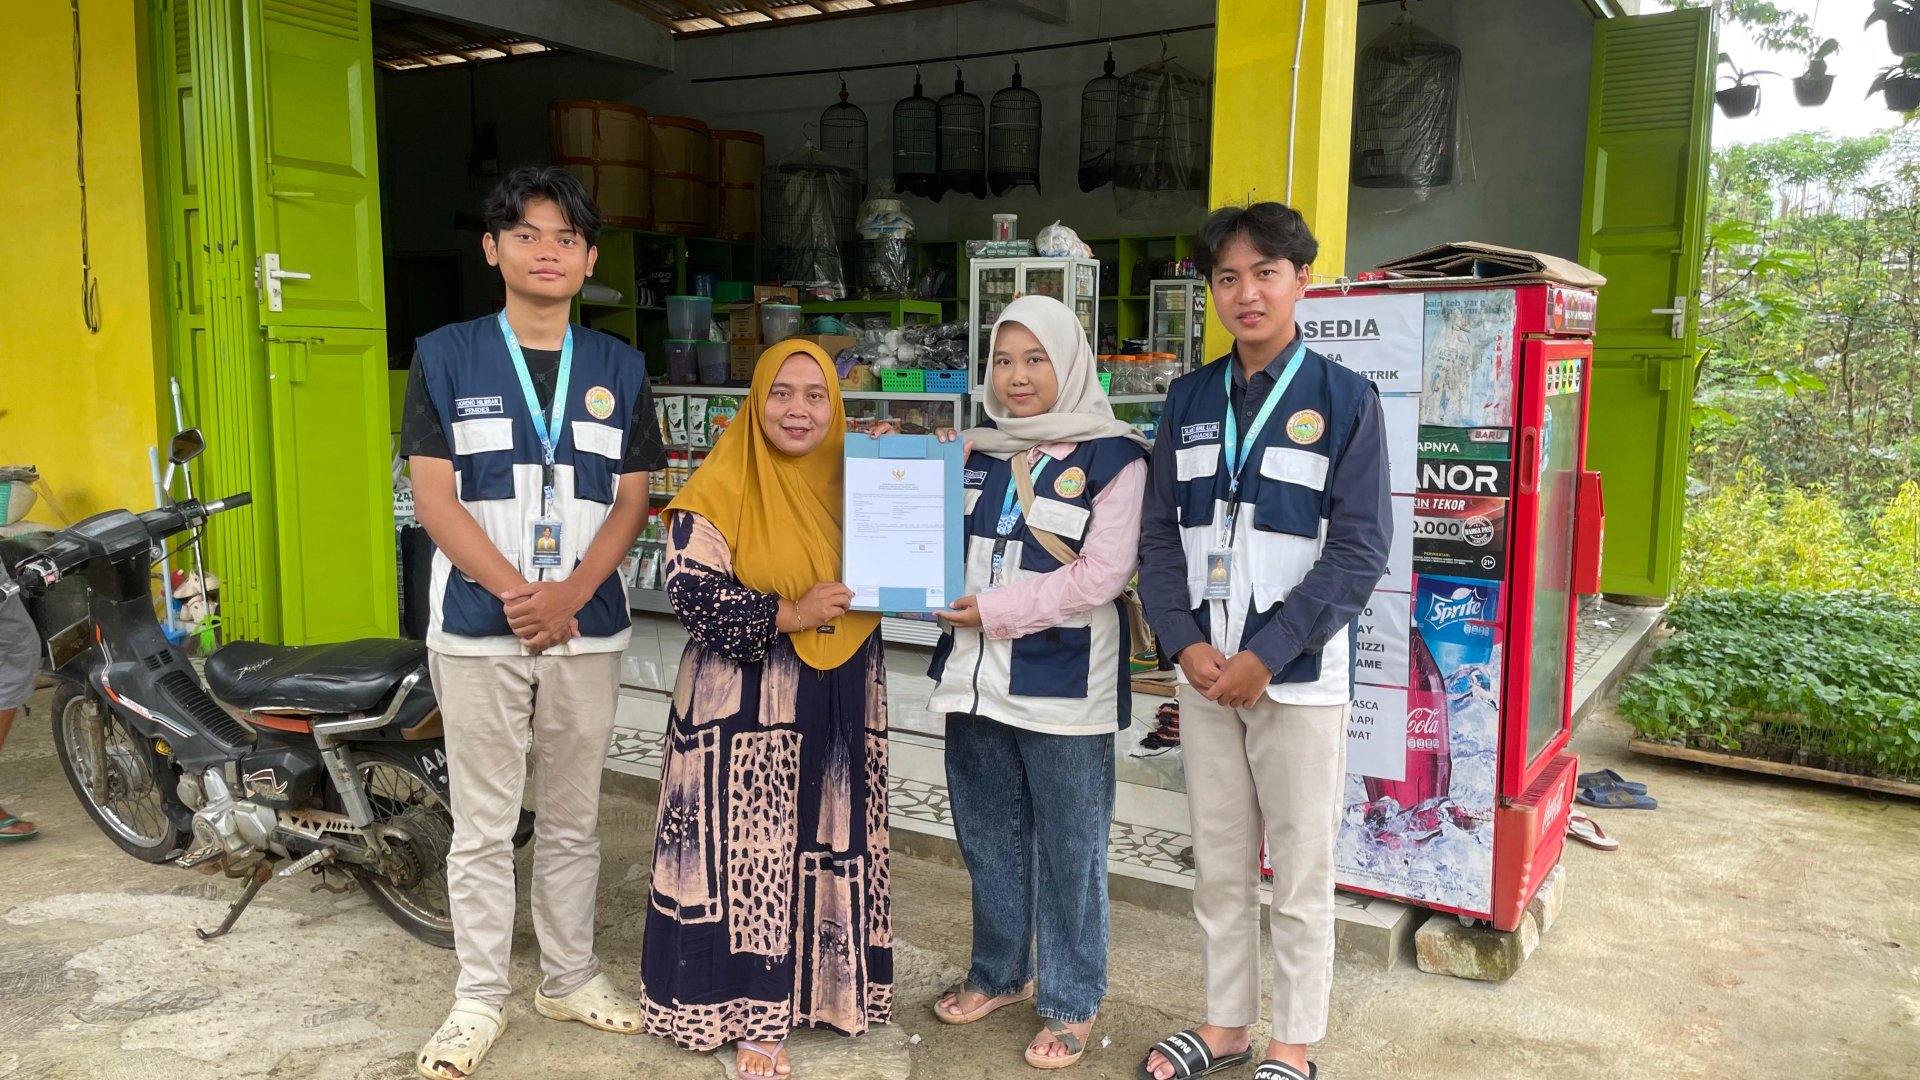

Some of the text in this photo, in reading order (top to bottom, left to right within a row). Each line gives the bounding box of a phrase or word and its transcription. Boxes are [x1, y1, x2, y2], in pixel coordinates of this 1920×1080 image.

[1304, 318, 1380, 338] SEDIA
[1322, 353, 1343, 362] SA
[1474, 430, 1504, 440] BARU
[1416, 442, 1460, 453] APNYA
[1432, 498, 1466, 511] TEKOR
[1359, 607, 1373, 617] O
[1430, 597, 1481, 624] Sprite
[1356, 658, 1382, 670] AME
[1357, 715, 1374, 726] API
